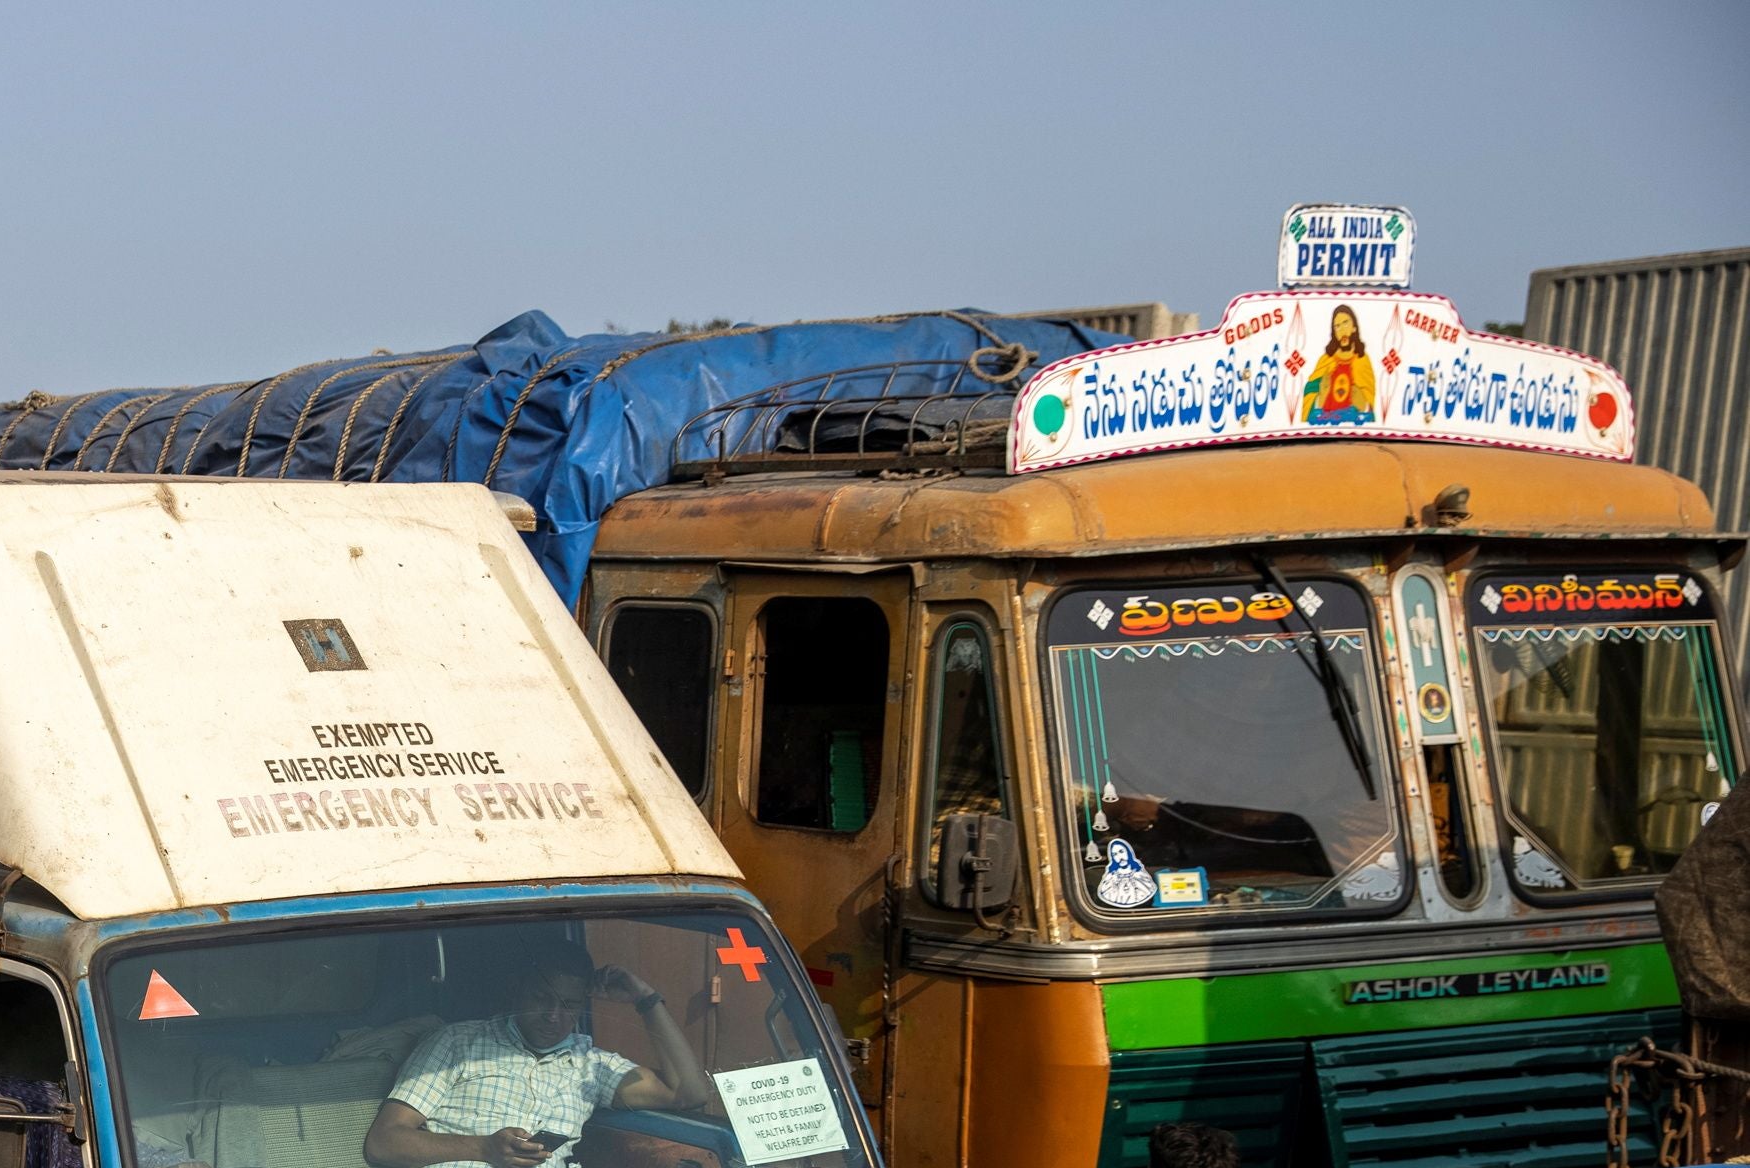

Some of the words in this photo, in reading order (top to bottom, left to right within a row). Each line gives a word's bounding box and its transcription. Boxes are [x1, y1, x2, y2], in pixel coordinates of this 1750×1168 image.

[1308, 216, 1335, 239] ALL
[1342, 216, 1384, 239] INDIA
[1296, 243, 1397, 277] PERMIT
[1225, 308, 1284, 345] GOODS
[1404, 308, 1460, 343] CARRIER
[311, 722, 434, 749] EXEMPTED
[264, 754, 406, 784] EMERGENCY
[404, 751, 505, 777] SERVICE
[217, 787, 439, 839] EMERGENCY
[454, 782, 603, 823] SERVICE
[1351, 974, 1459, 1003] ASHOK
[1477, 963, 1611, 993] LEYLAND
[736, 1097, 749, 1107] ON
[749, 1089, 796, 1105] EMERGENCY
[797, 1085, 817, 1096] DUTY
[751, 1078, 776, 1090] COVID
[747, 1113, 765, 1125] NOT
[766, 1111, 778, 1120] TO
[780, 1110, 789, 1119] BE
[789, 1103, 826, 1117] DETAINED
[755, 1125, 787, 1139] HEALTH
[787, 1124, 794, 1134] &
[795, 1119, 822, 1132] FAMILY
